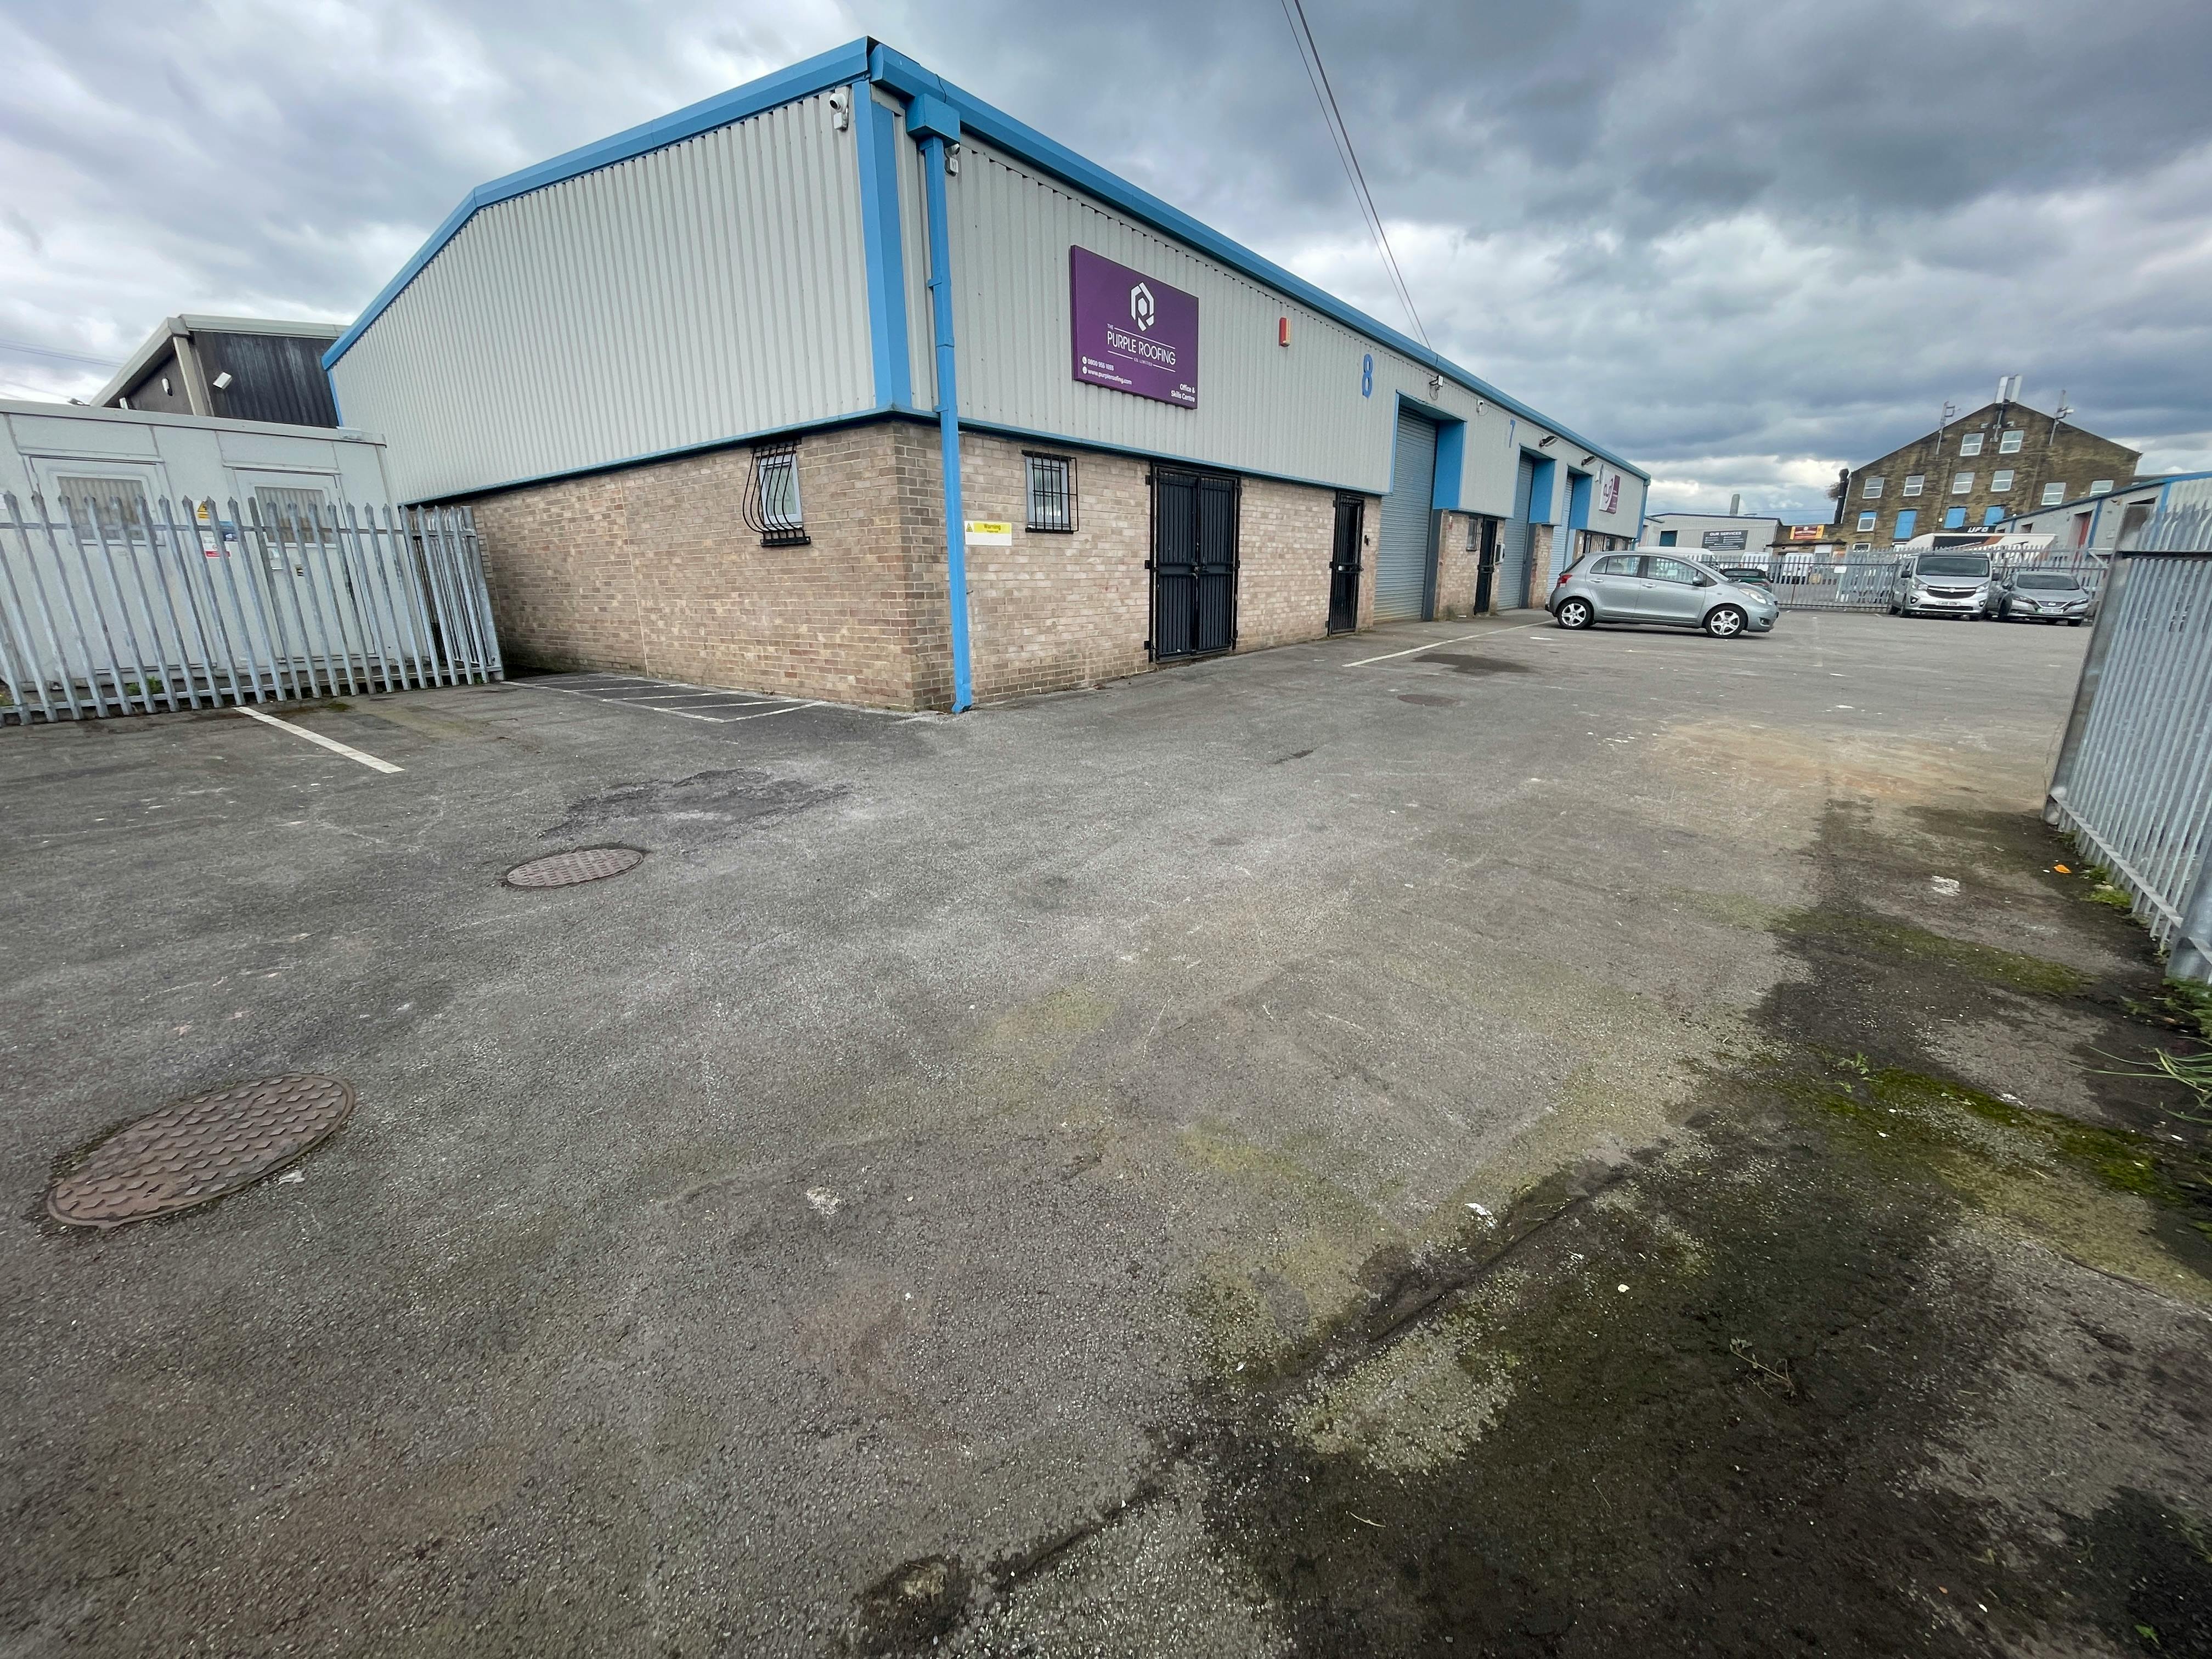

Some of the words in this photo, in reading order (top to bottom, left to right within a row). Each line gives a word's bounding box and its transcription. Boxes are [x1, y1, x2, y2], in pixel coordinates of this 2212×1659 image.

[1107, 331, 1136, 353] PURPLE
[1138, 341, 1176, 365] ROOFING
[1180, 383, 1192, 392] Office
[1362, 354, 1373, 398] 8
[1171, 390, 1182, 399] Skills
[1182, 393, 1195, 402] Centre
[1509, 418, 1516, 448] 7
